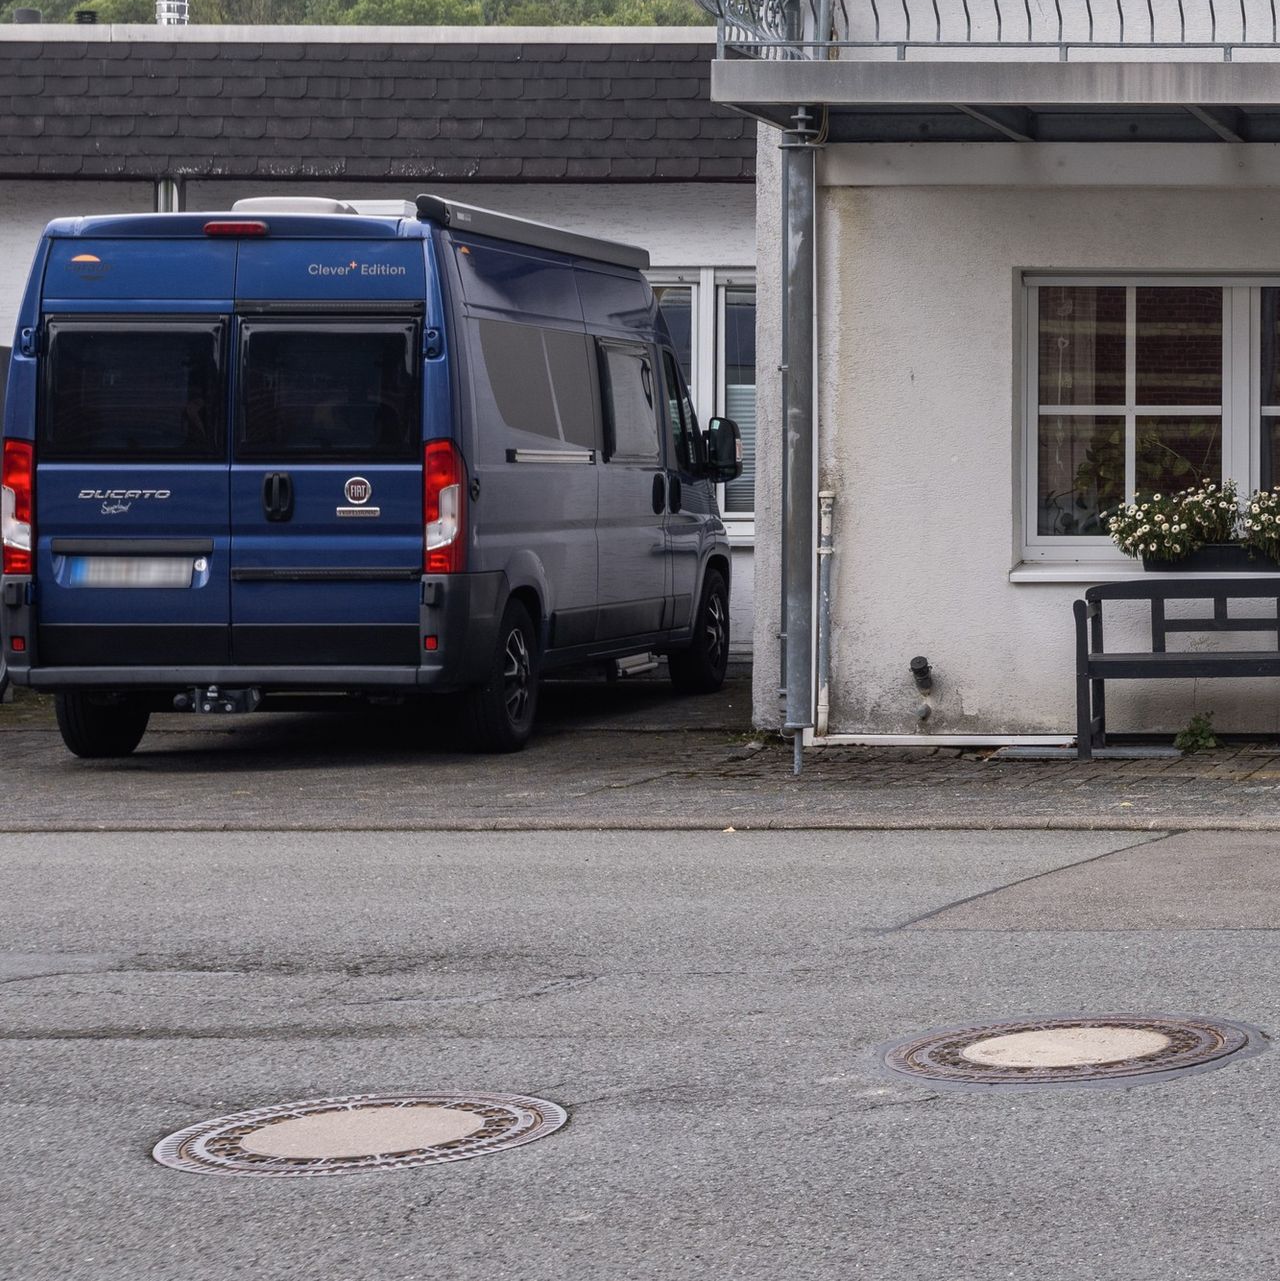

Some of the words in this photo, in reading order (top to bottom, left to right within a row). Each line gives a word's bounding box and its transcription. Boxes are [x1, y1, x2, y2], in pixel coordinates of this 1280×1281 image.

[361, 263, 406, 276] Edition
[78, 489, 171, 499] DUCATO
[350, 484, 366, 498] FIAT
